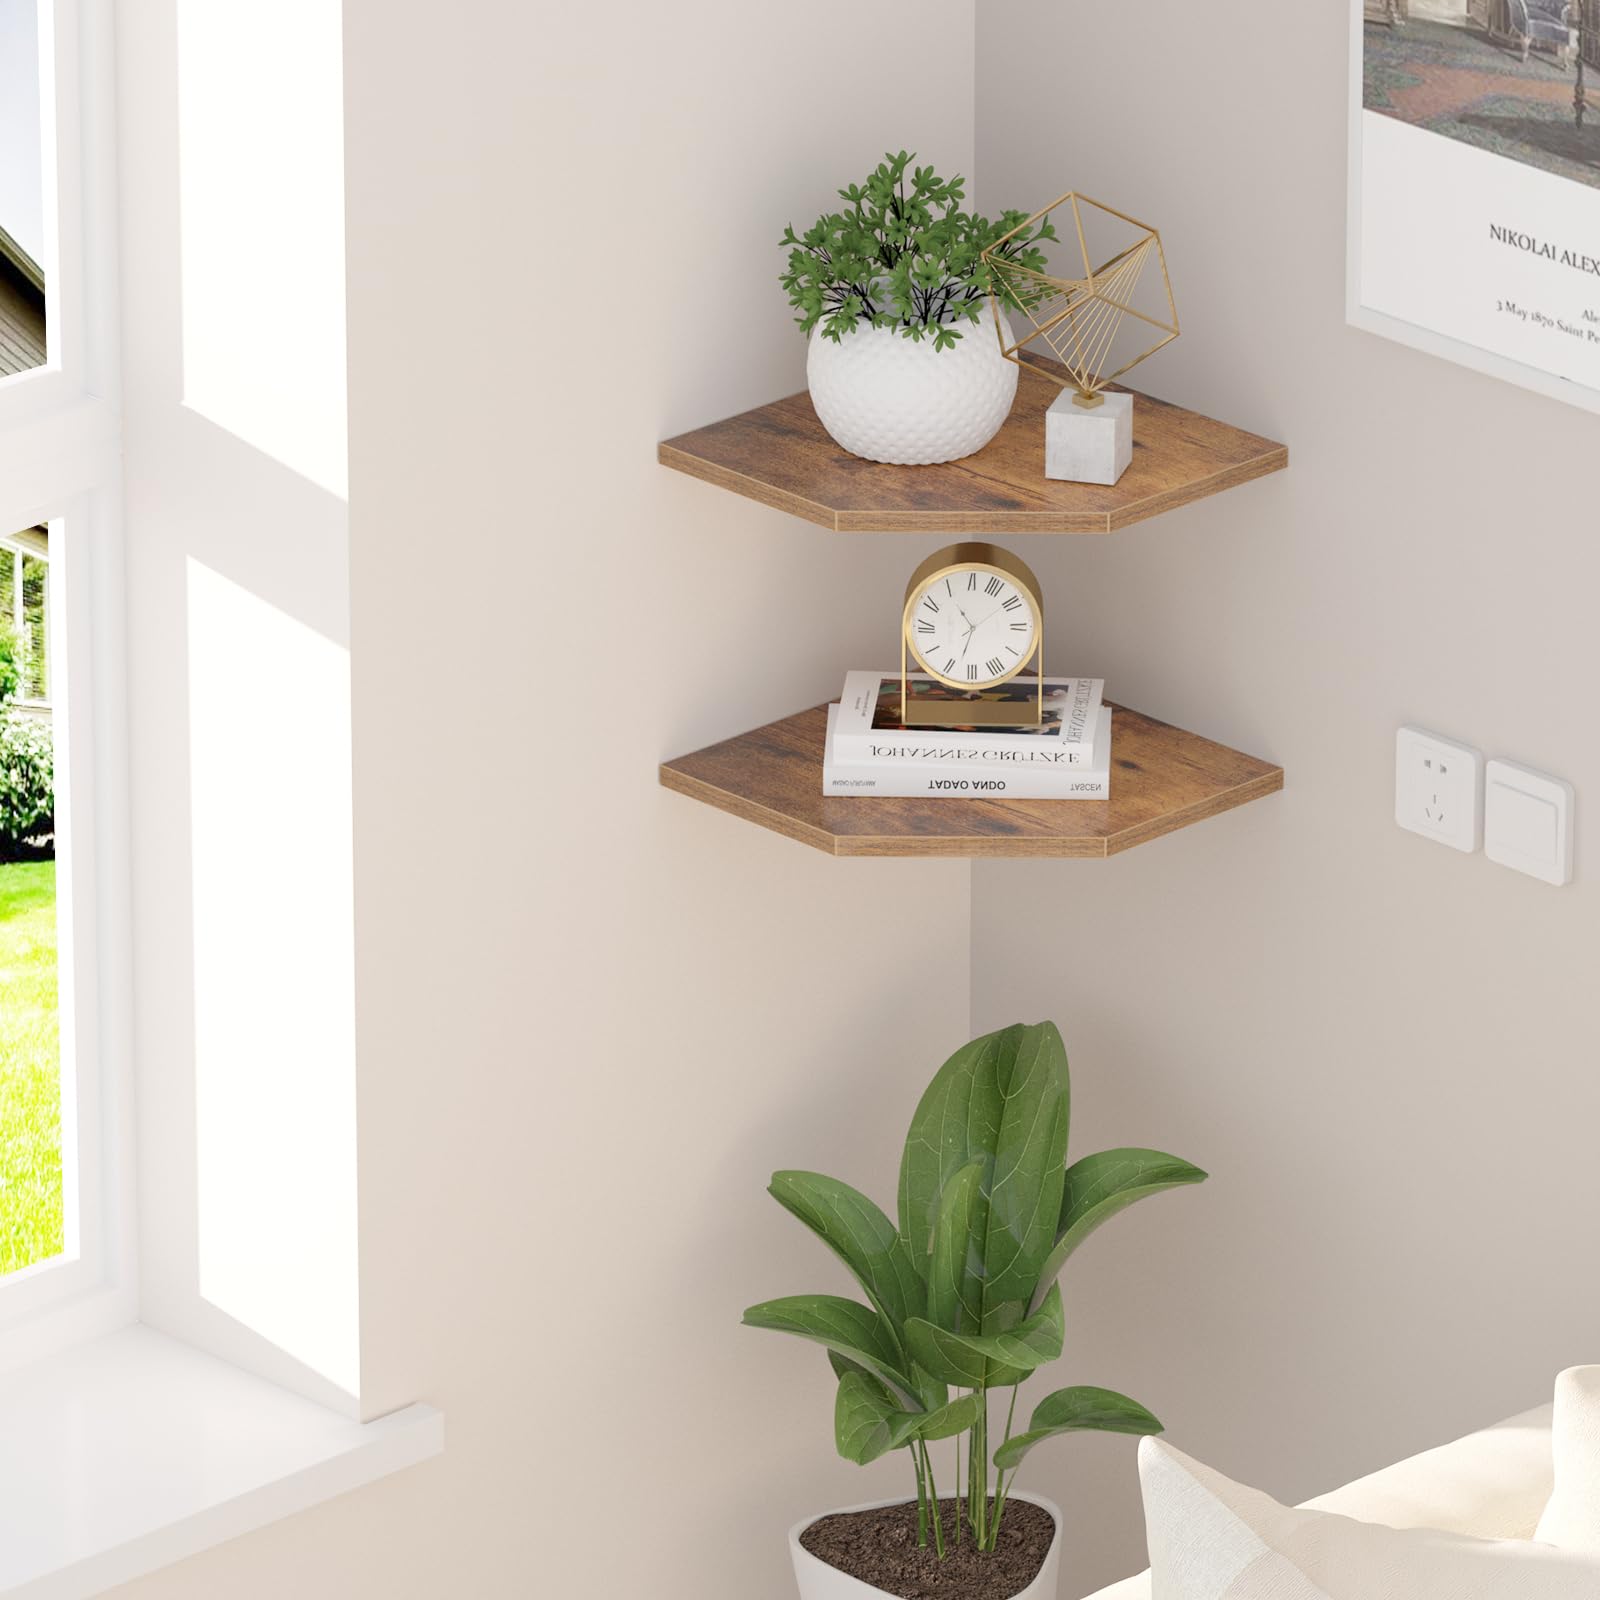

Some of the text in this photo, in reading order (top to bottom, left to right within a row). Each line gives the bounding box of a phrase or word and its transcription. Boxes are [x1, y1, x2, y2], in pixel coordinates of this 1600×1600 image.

[1489, 223, 1600, 277] NIKOLAI ALEX
[1505, 300, 1528, 321] May
[1557, 319, 1584, 339] Saint
